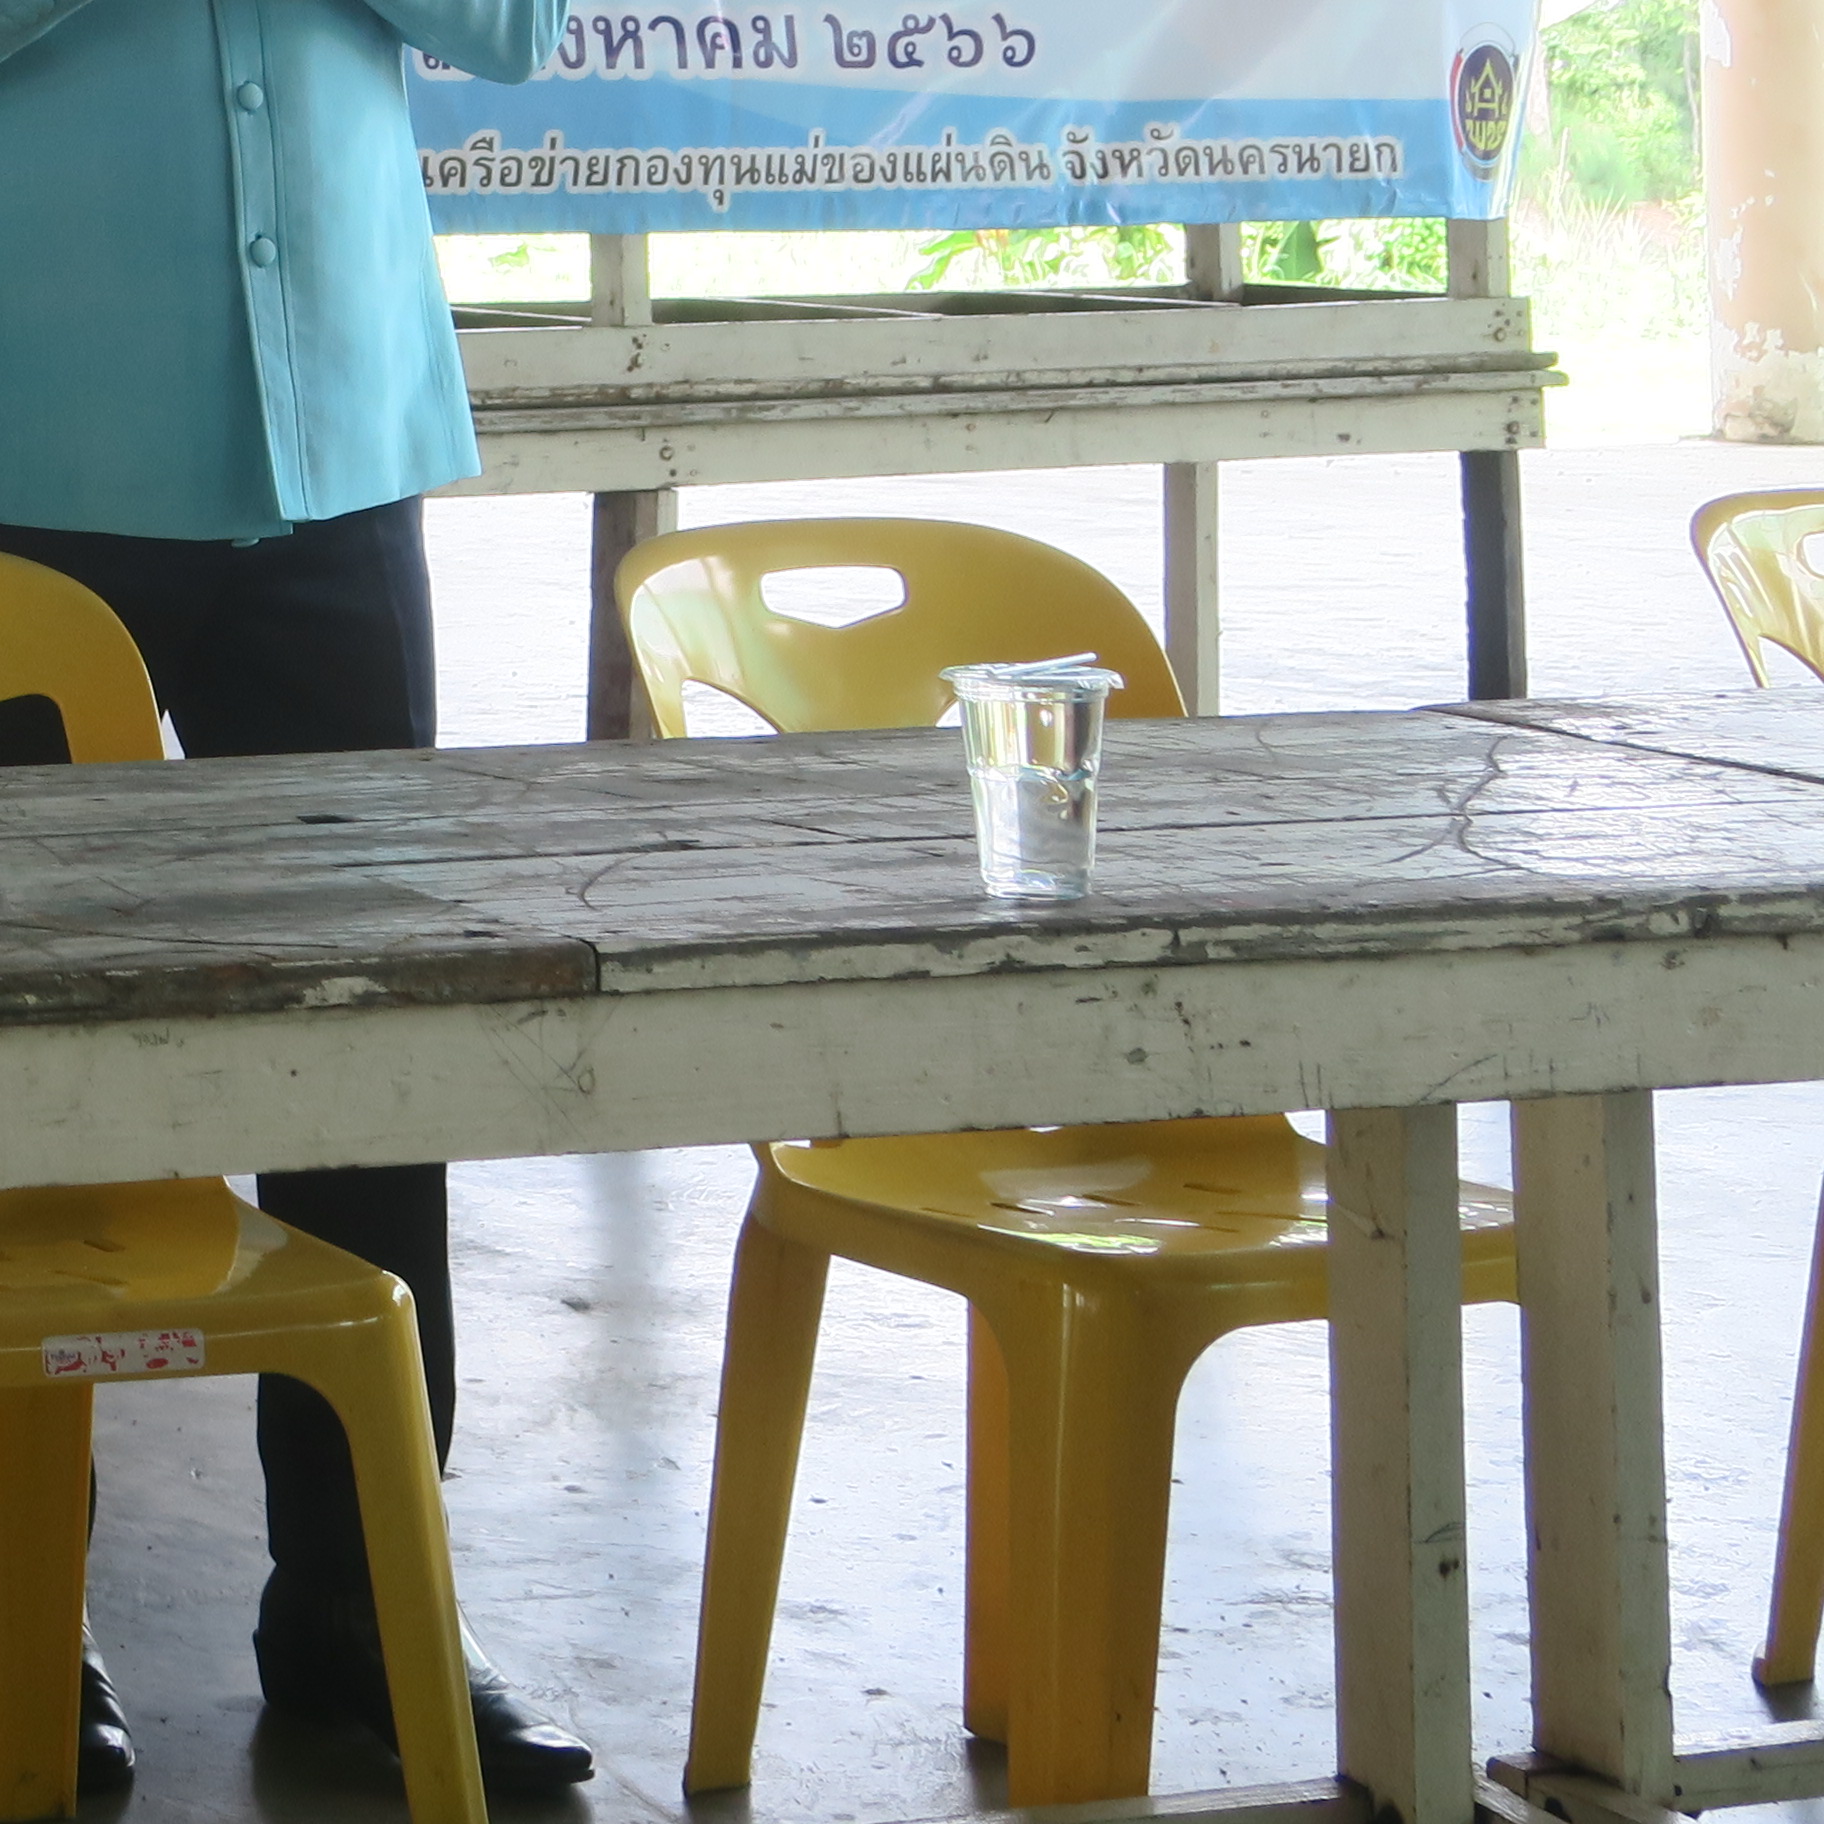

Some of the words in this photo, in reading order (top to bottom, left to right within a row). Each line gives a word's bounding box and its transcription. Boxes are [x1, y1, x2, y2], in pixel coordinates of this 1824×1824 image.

[540, 13, 799, 71] งหาคม
[823, 12, 1037, 70] ๒๕๖๖
[421, 133, 1051, 206] เครือข่ายกองทุนแม่ของแผ่นดิน
[1061, 127, 1398, 181] จังหวัดนครนายก
